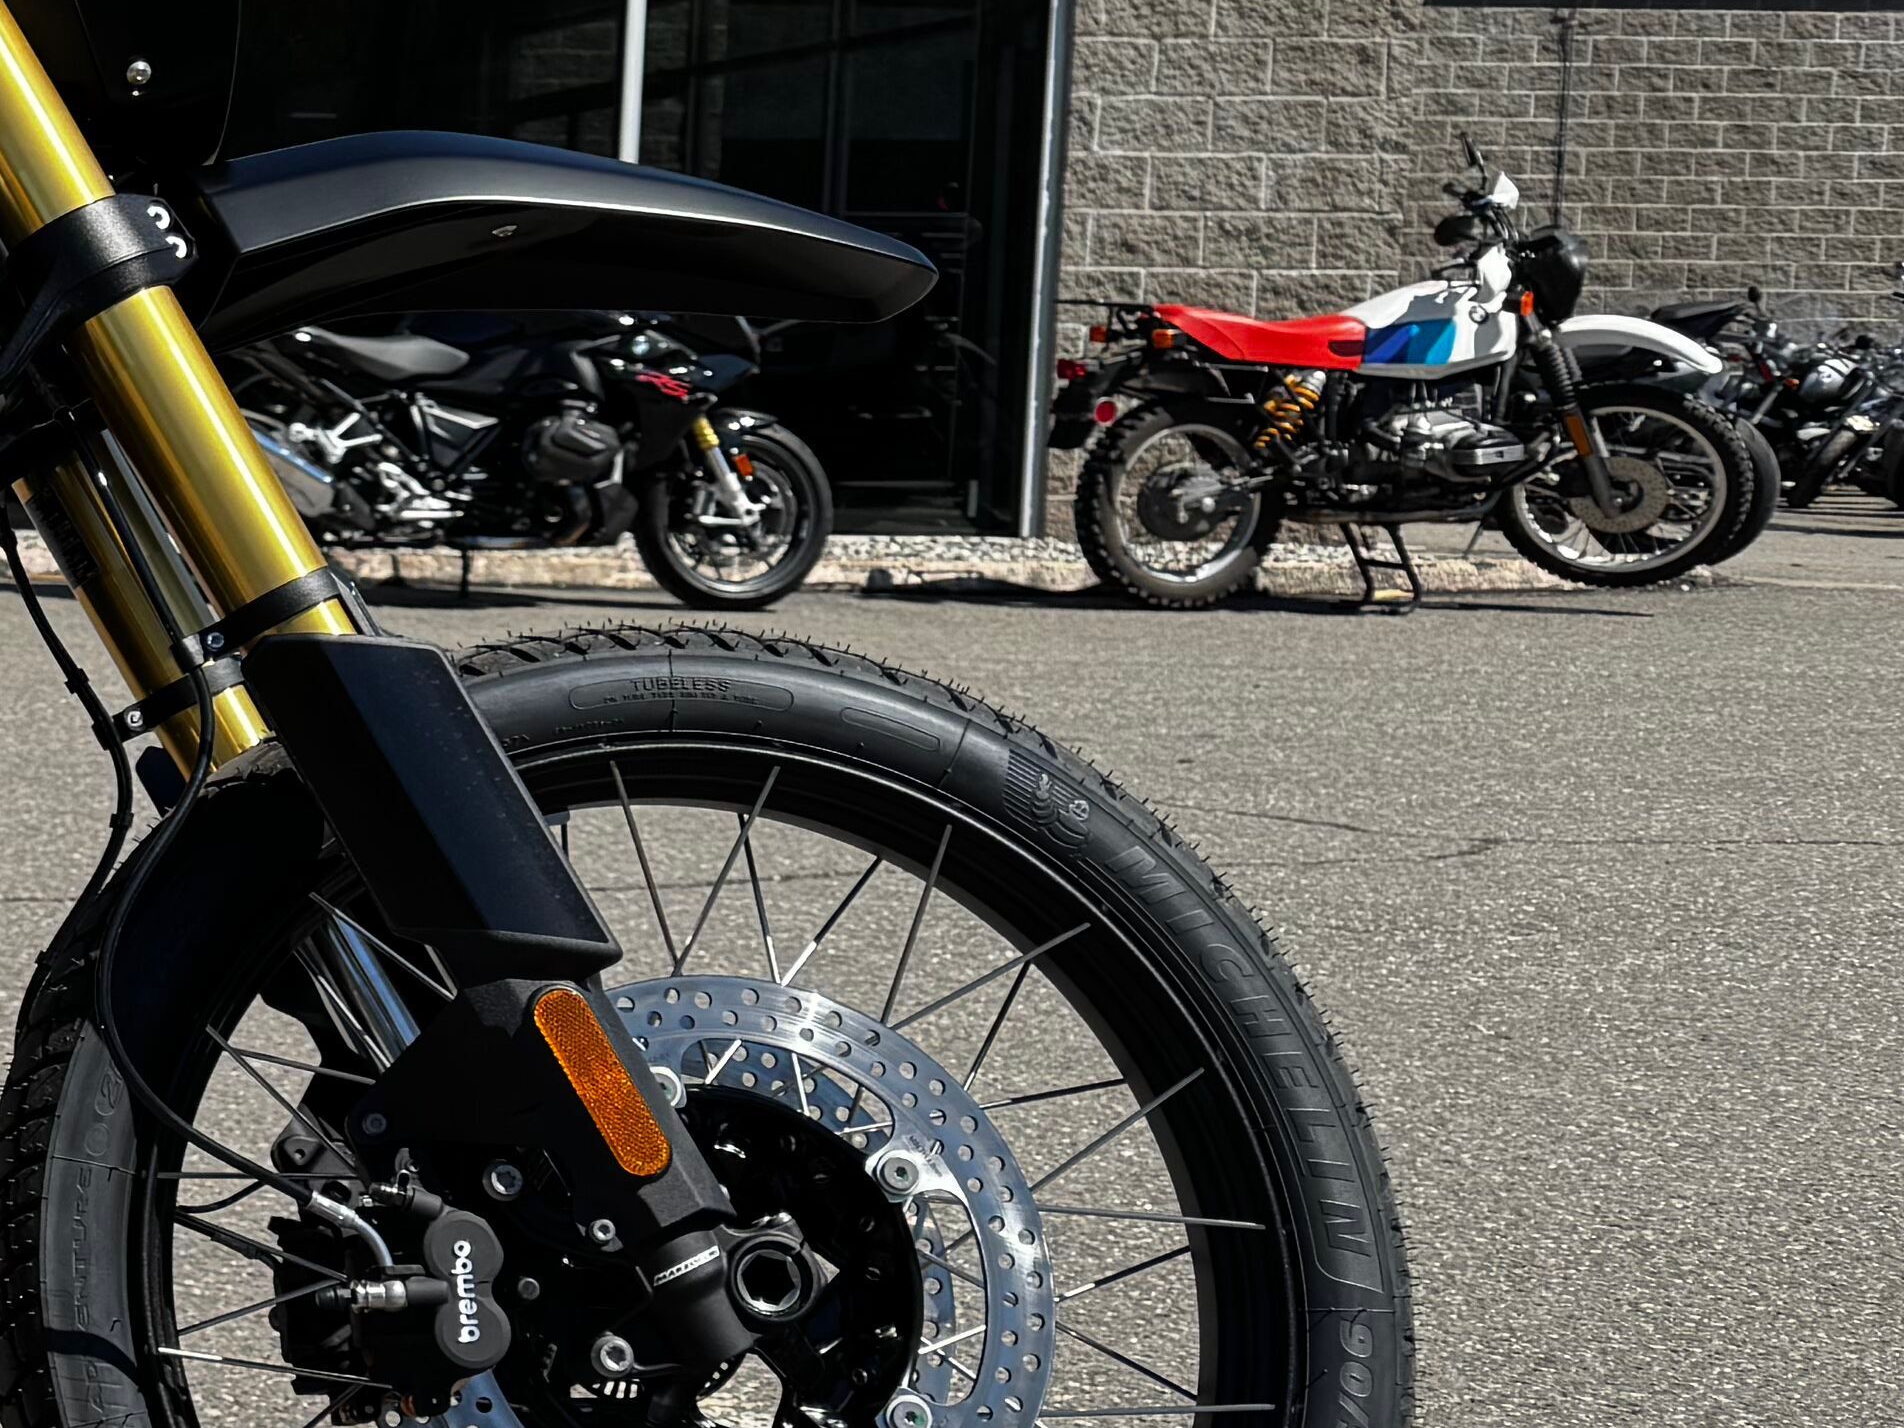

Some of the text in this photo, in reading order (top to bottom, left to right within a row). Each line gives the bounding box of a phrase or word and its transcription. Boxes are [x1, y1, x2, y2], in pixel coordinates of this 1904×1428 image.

[630, 676, 732, 692] TUBELESS
[1103, 836, 1370, 1262] MICHELIN
[451, 1240, 480, 1343] brembo
